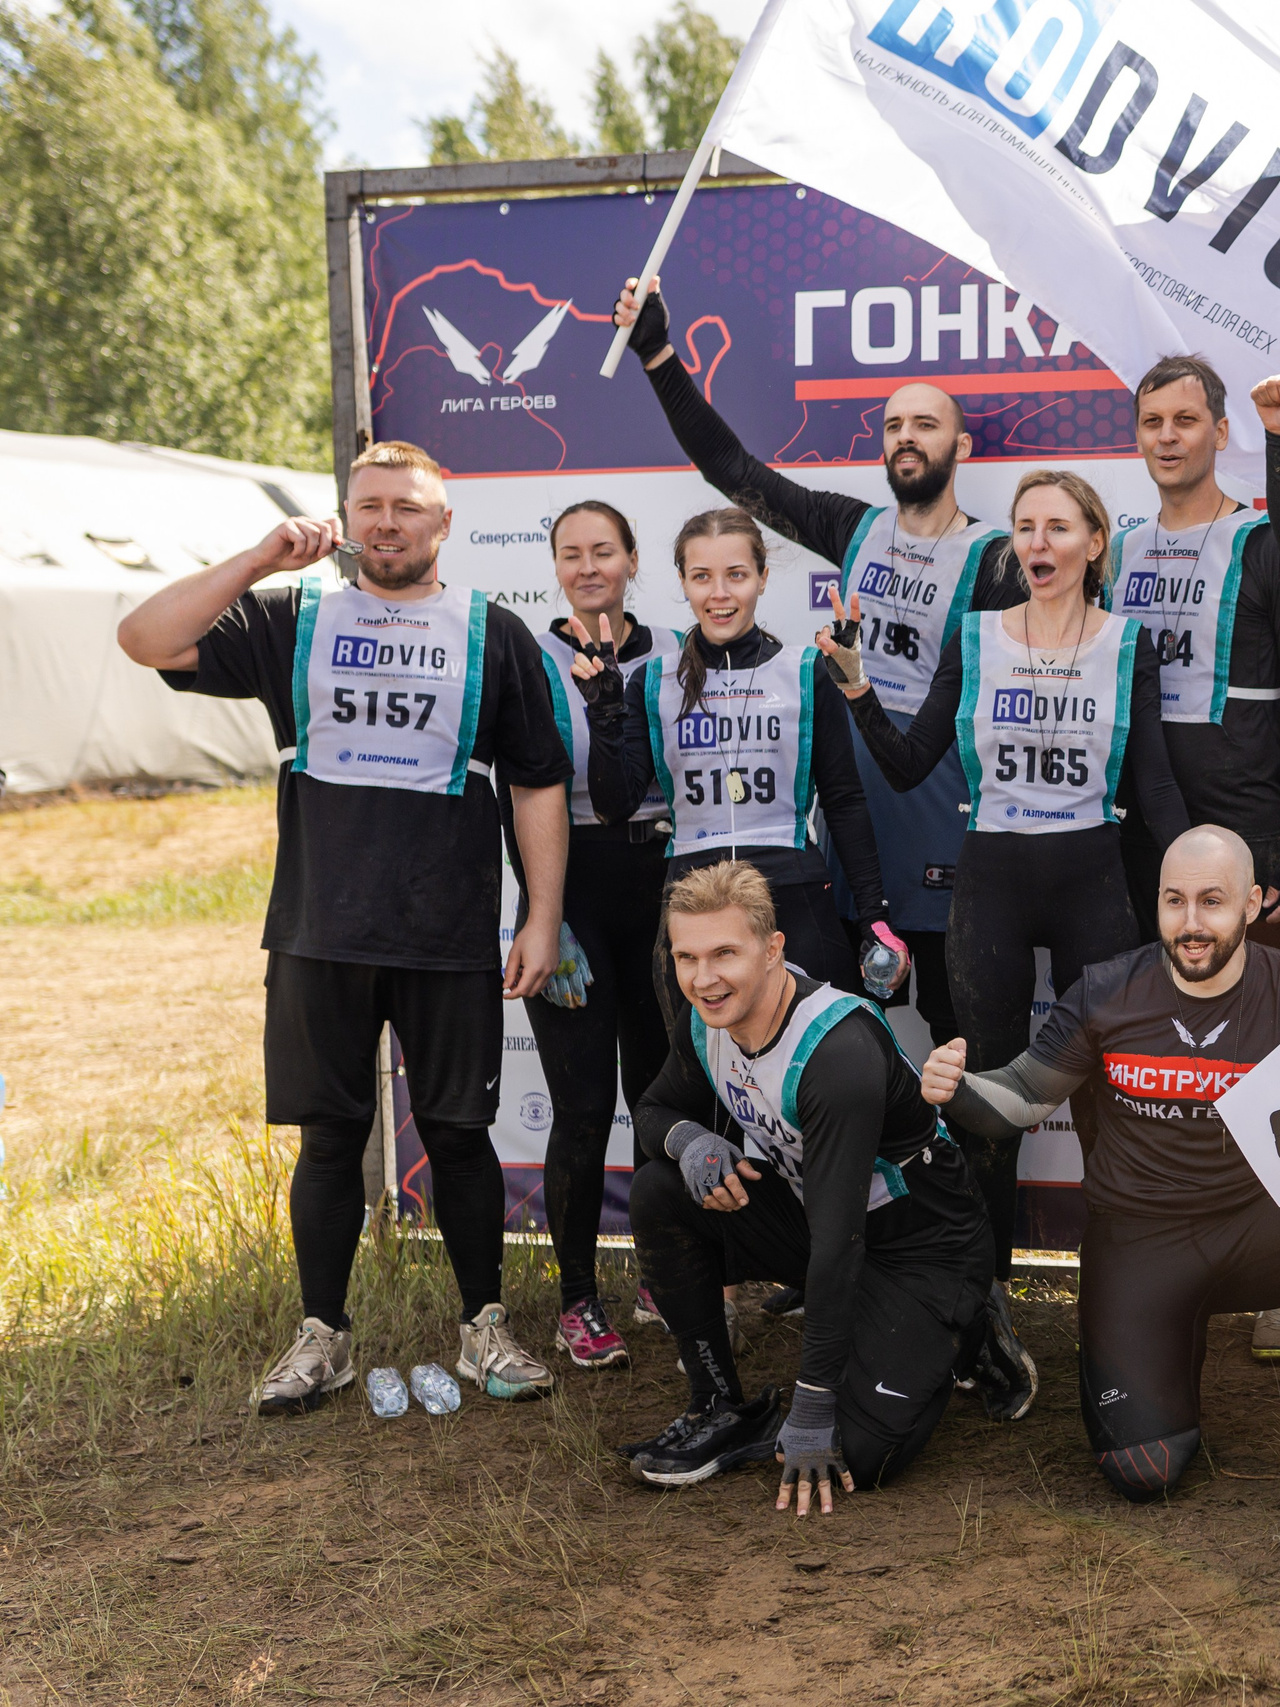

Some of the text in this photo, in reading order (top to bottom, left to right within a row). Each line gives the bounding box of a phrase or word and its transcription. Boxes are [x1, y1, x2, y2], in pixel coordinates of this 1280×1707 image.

[853, 49, 950, 106] НАДЕЖНОСТЬ
[949, 101, 985, 127] ДЛЯ
[1203, 302, 1241, 333] ДЛЯ
[1236, 319, 1278, 355] ВСЕХ
[440, 394, 557, 413] ЛИГА ГЕРОЕВ
[469, 530, 548, 547] Северсталь
[1145, 548, 1199, 558] ГОНКА ГЕРОЕВ
[485, 590, 549, 604] ANK
[860, 565, 938, 606] RODVIG
[1126, 576, 1206, 605] RODVIG
[356, 616, 430, 627] ГОНКА ГЕРОЕВ
[336, 638, 446, 669] RODVIG
[1012, 667, 1082, 677] ГОНКА ГЕРОЕВ
[700, 688, 764, 698] ОНКА ГЕРОЕВ
[331, 686, 437, 731] 5157
[996, 693, 1096, 723] RODVIG
[681, 714, 781, 745] RODVIG
[357, 753, 420, 767] ГАЗПРОМБАНК
[995, 743, 1090, 788] 5165
[1022, 808, 1076, 820] ГАЗПРОМБАНК
[695, 1339, 731, 1397] ATHLEX
